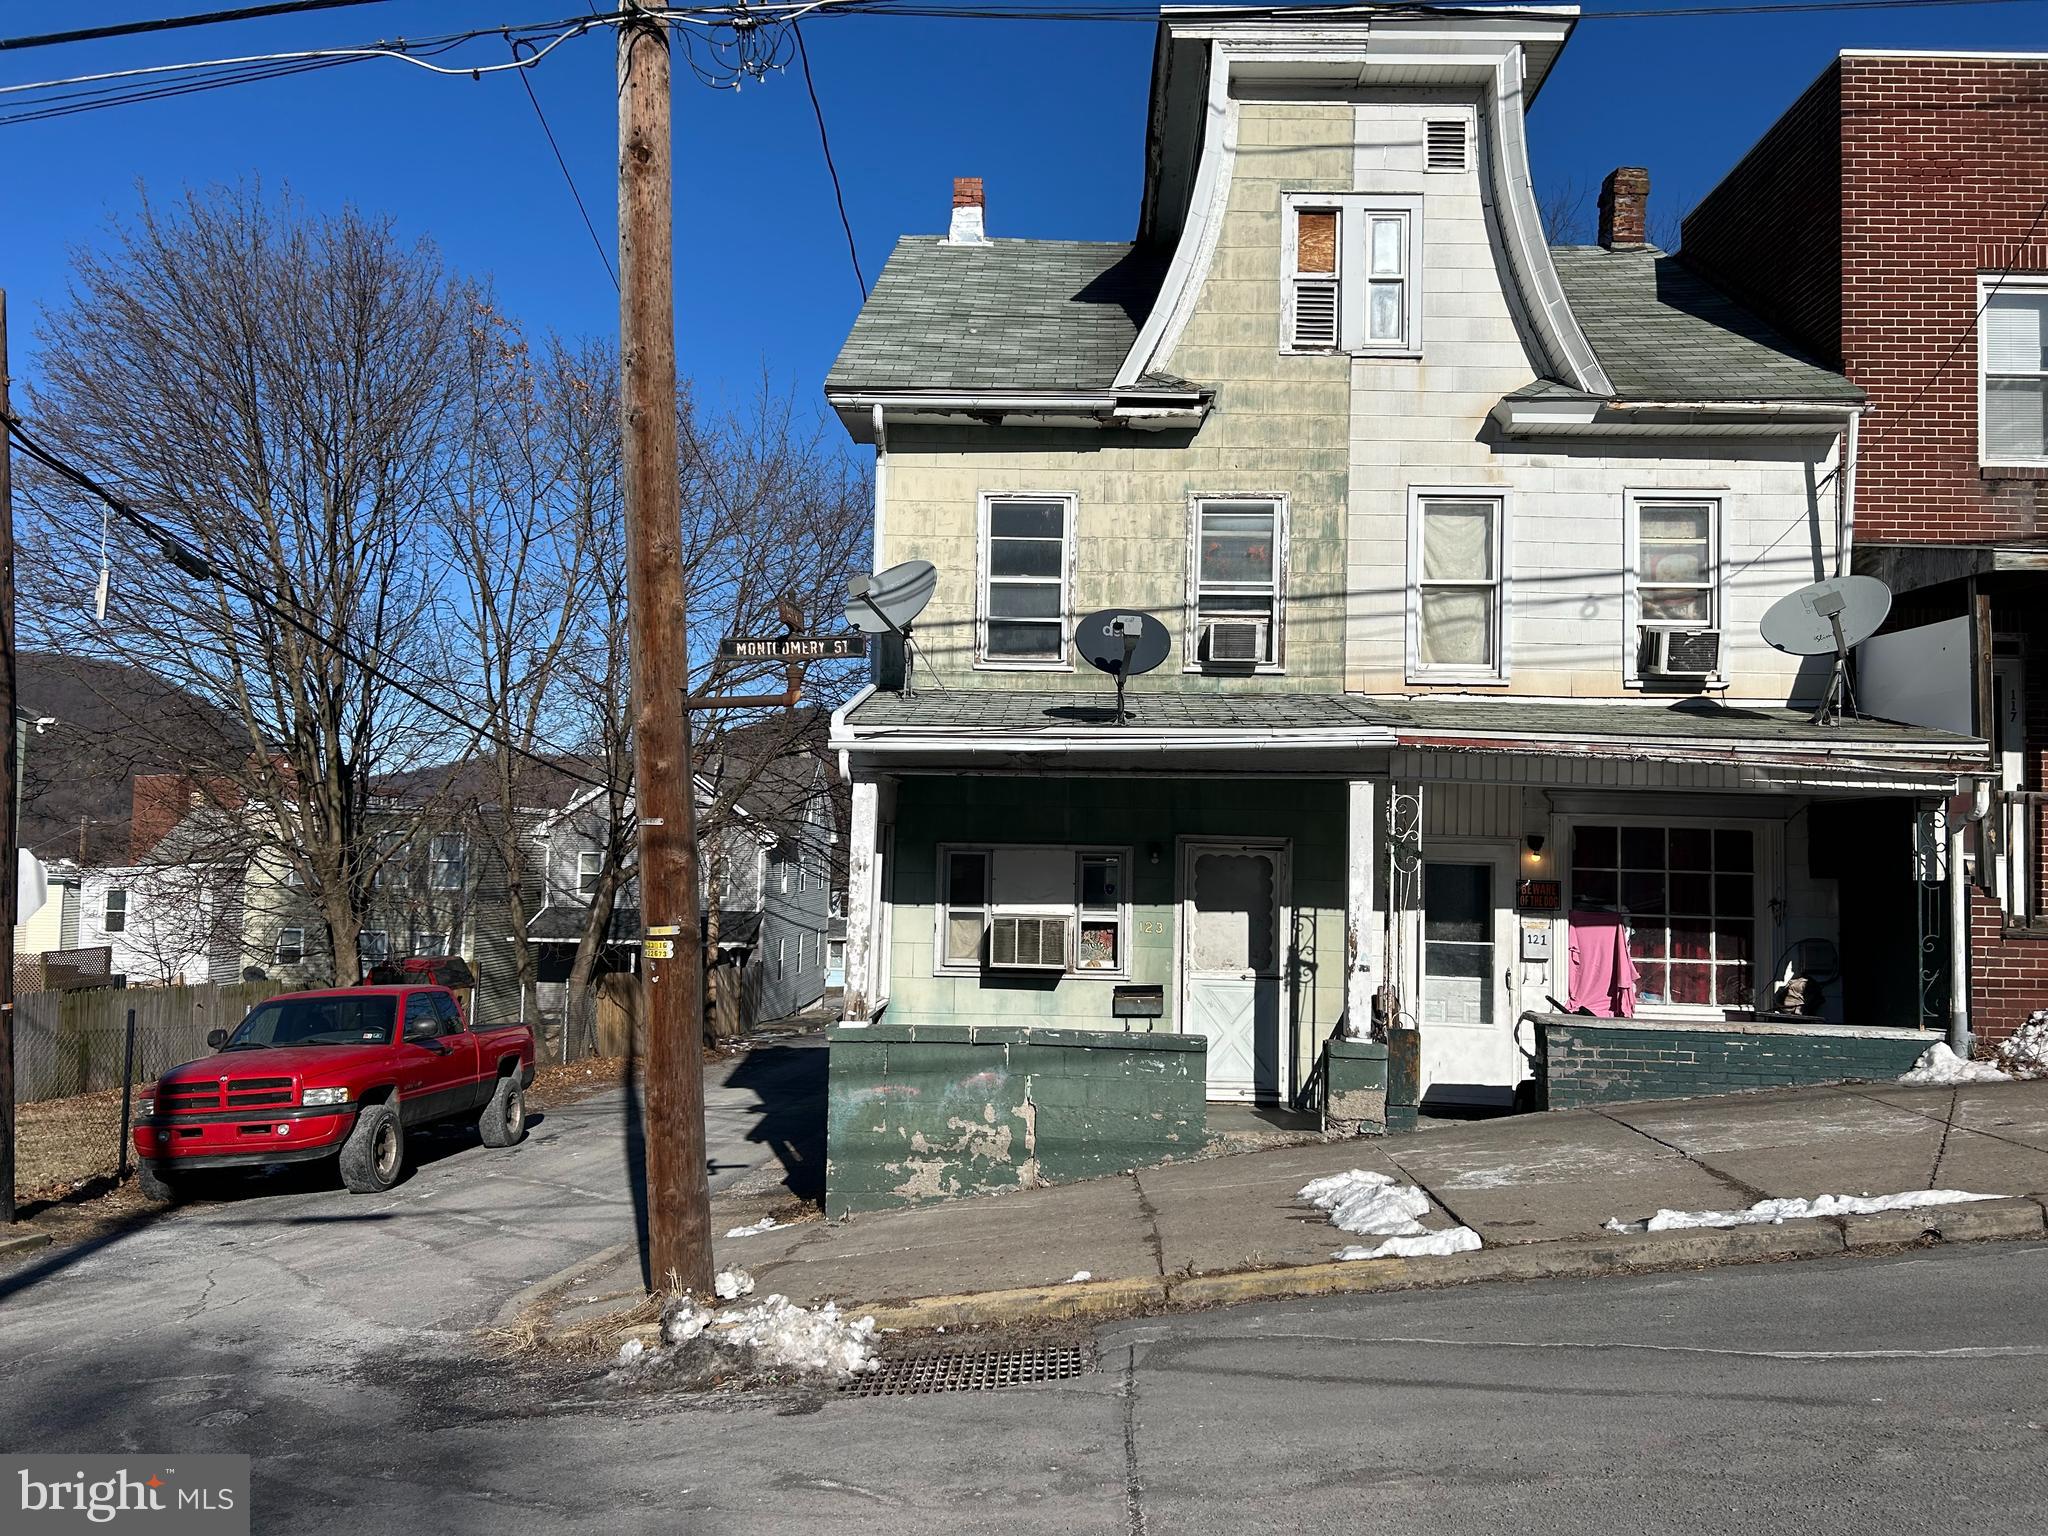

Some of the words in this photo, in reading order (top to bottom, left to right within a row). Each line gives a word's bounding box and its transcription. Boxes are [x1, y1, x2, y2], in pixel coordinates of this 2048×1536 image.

[834, 640, 849, 654] ST
[1521, 883, 1557, 895] BEWARE
[1520, 895, 1529, 906] OF
[1531, 895, 1543, 906] THE
[1544, 896, 1559, 907] DOG
[1138, 921, 1164, 934] 123
[1527, 934, 1548, 946] 121
